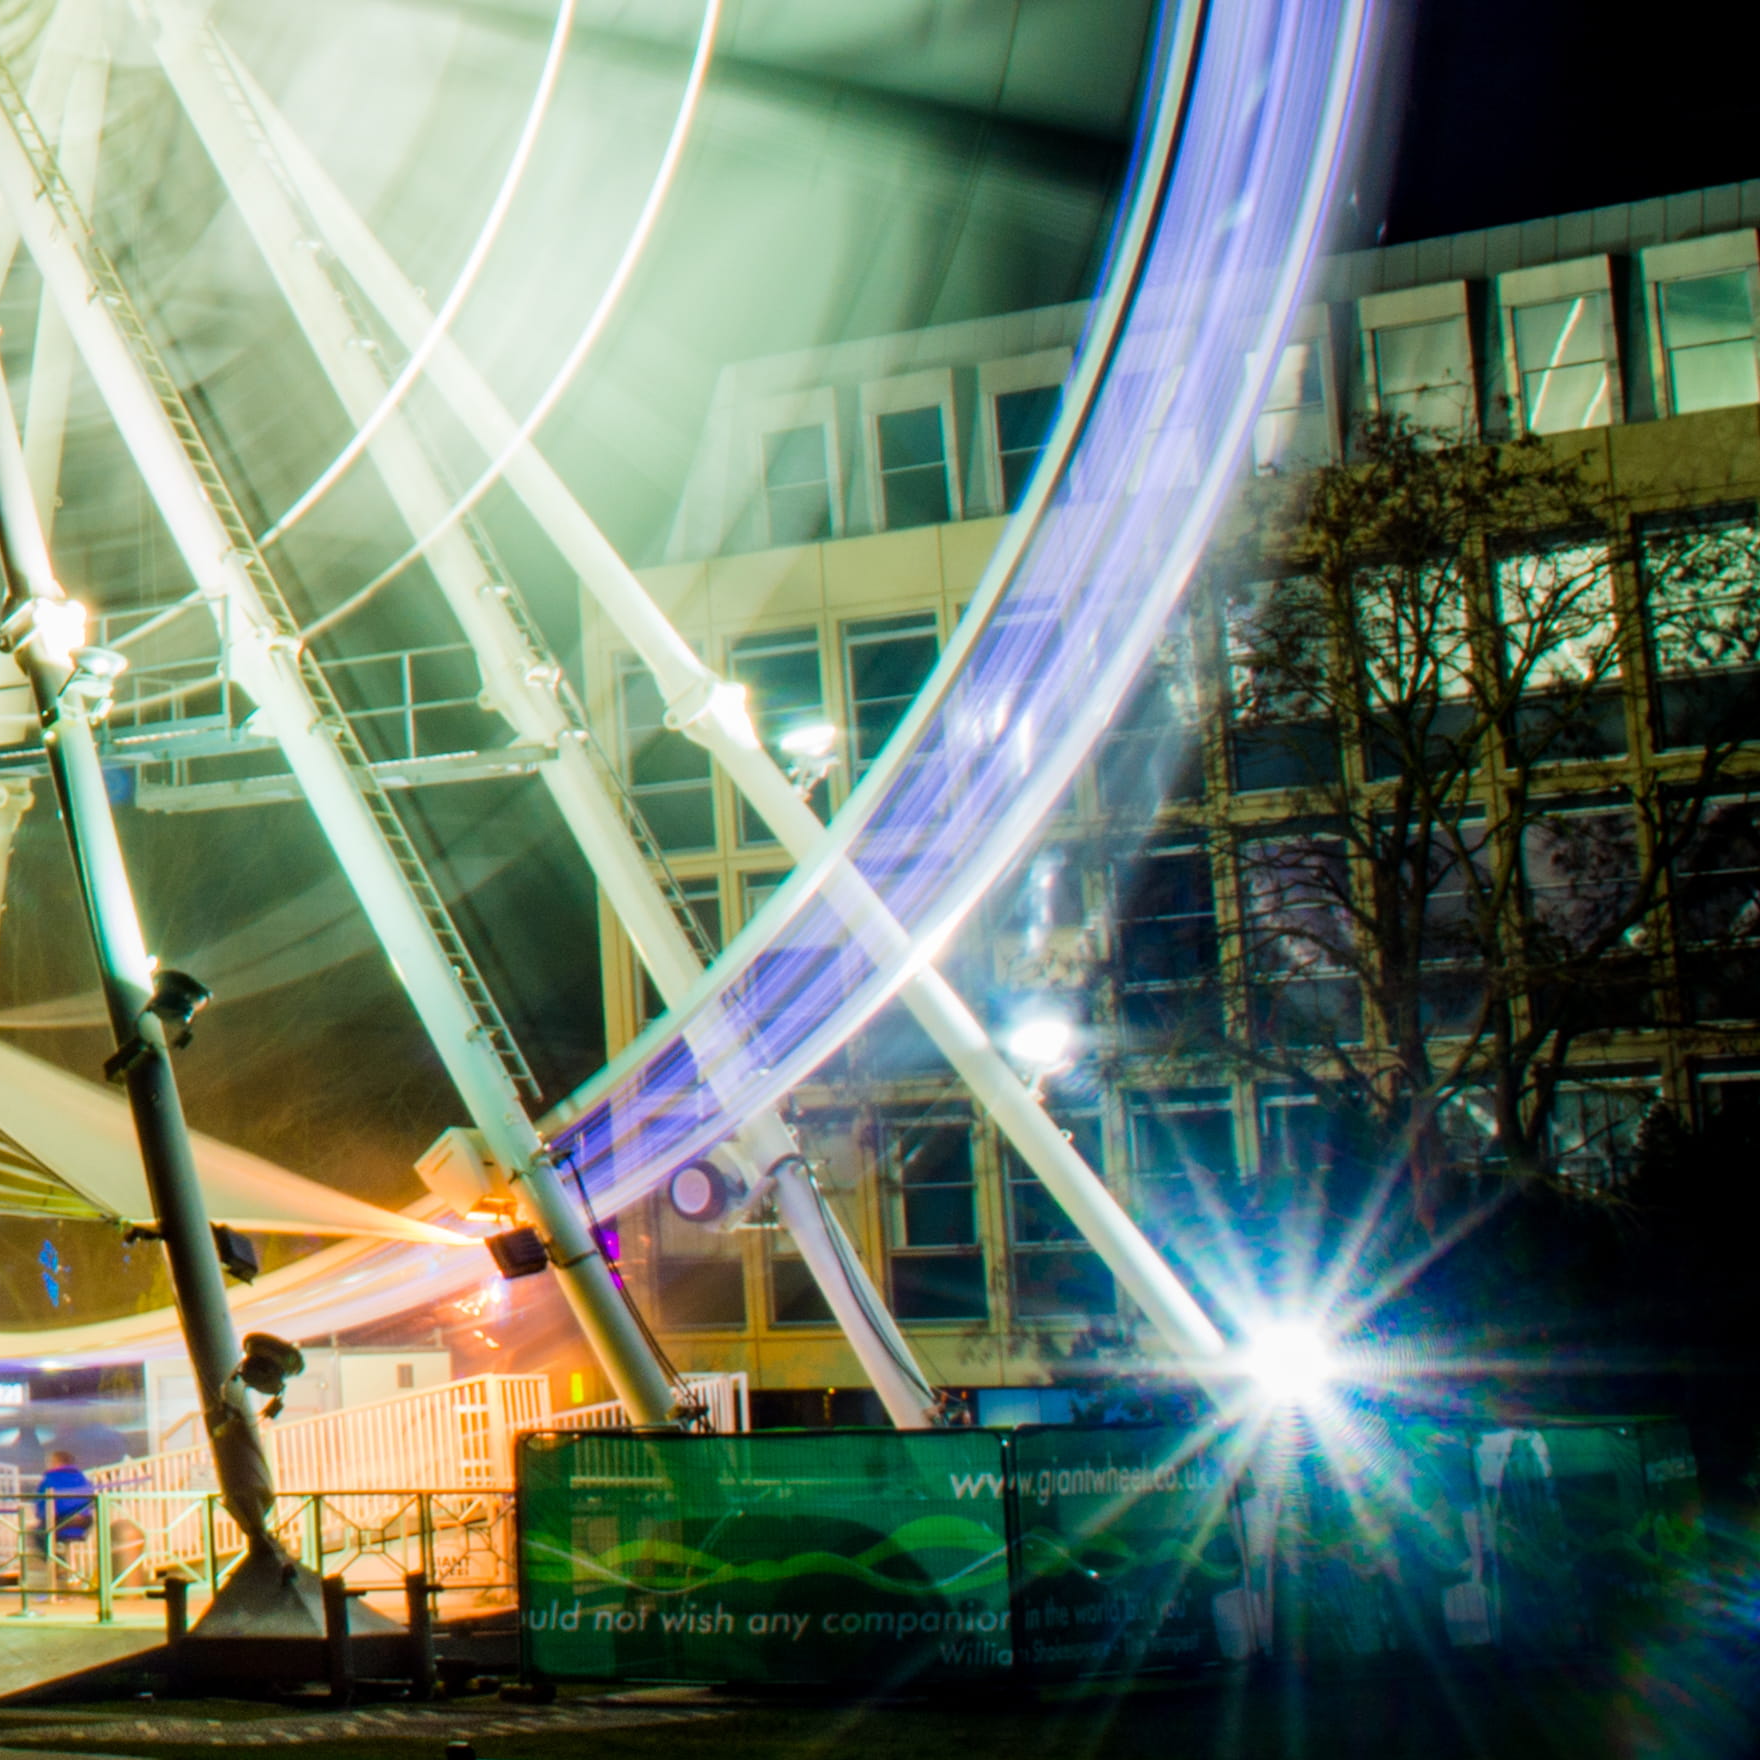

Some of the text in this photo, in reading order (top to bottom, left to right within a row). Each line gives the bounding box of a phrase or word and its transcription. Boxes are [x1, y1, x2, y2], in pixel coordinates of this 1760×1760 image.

[522, 1600, 580, 1631] uld
[594, 1604, 647, 1631] not
[660, 1602, 735, 1633] wish
[748, 1612, 809, 1641] any
